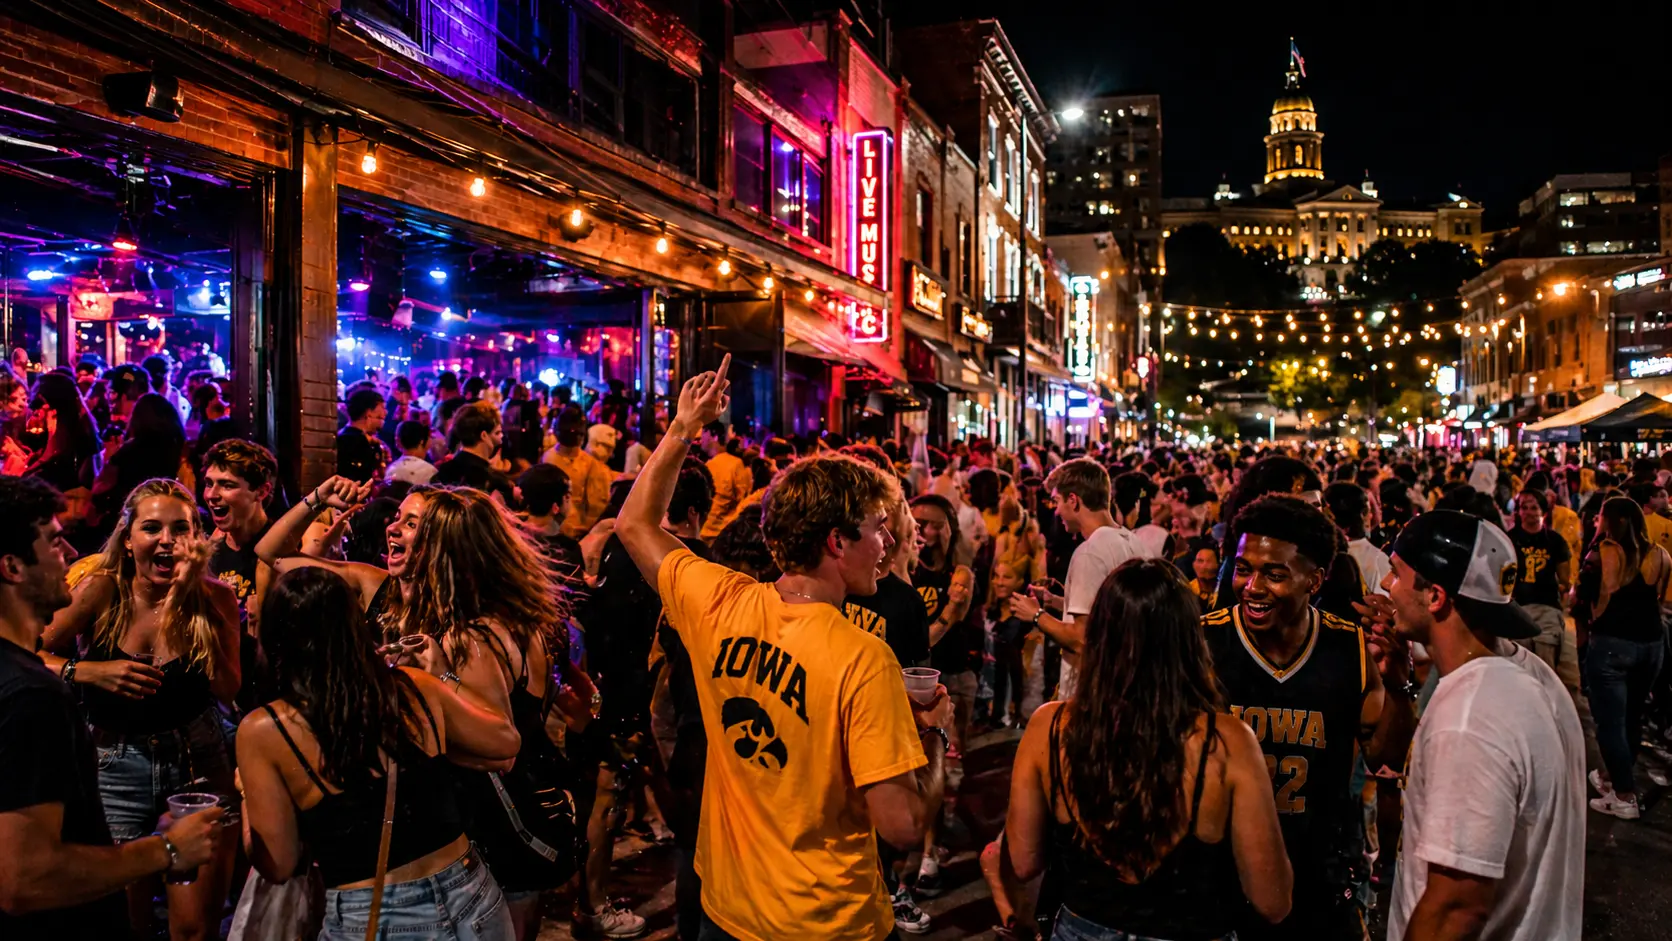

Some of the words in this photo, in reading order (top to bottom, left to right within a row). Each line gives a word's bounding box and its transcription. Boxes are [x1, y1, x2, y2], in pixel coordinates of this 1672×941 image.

[860, 139, 878, 218] LIVE
[860, 223, 879, 335] MUSC
[845, 602, 887, 641] WA
[712, 636, 809, 726] IOWA
